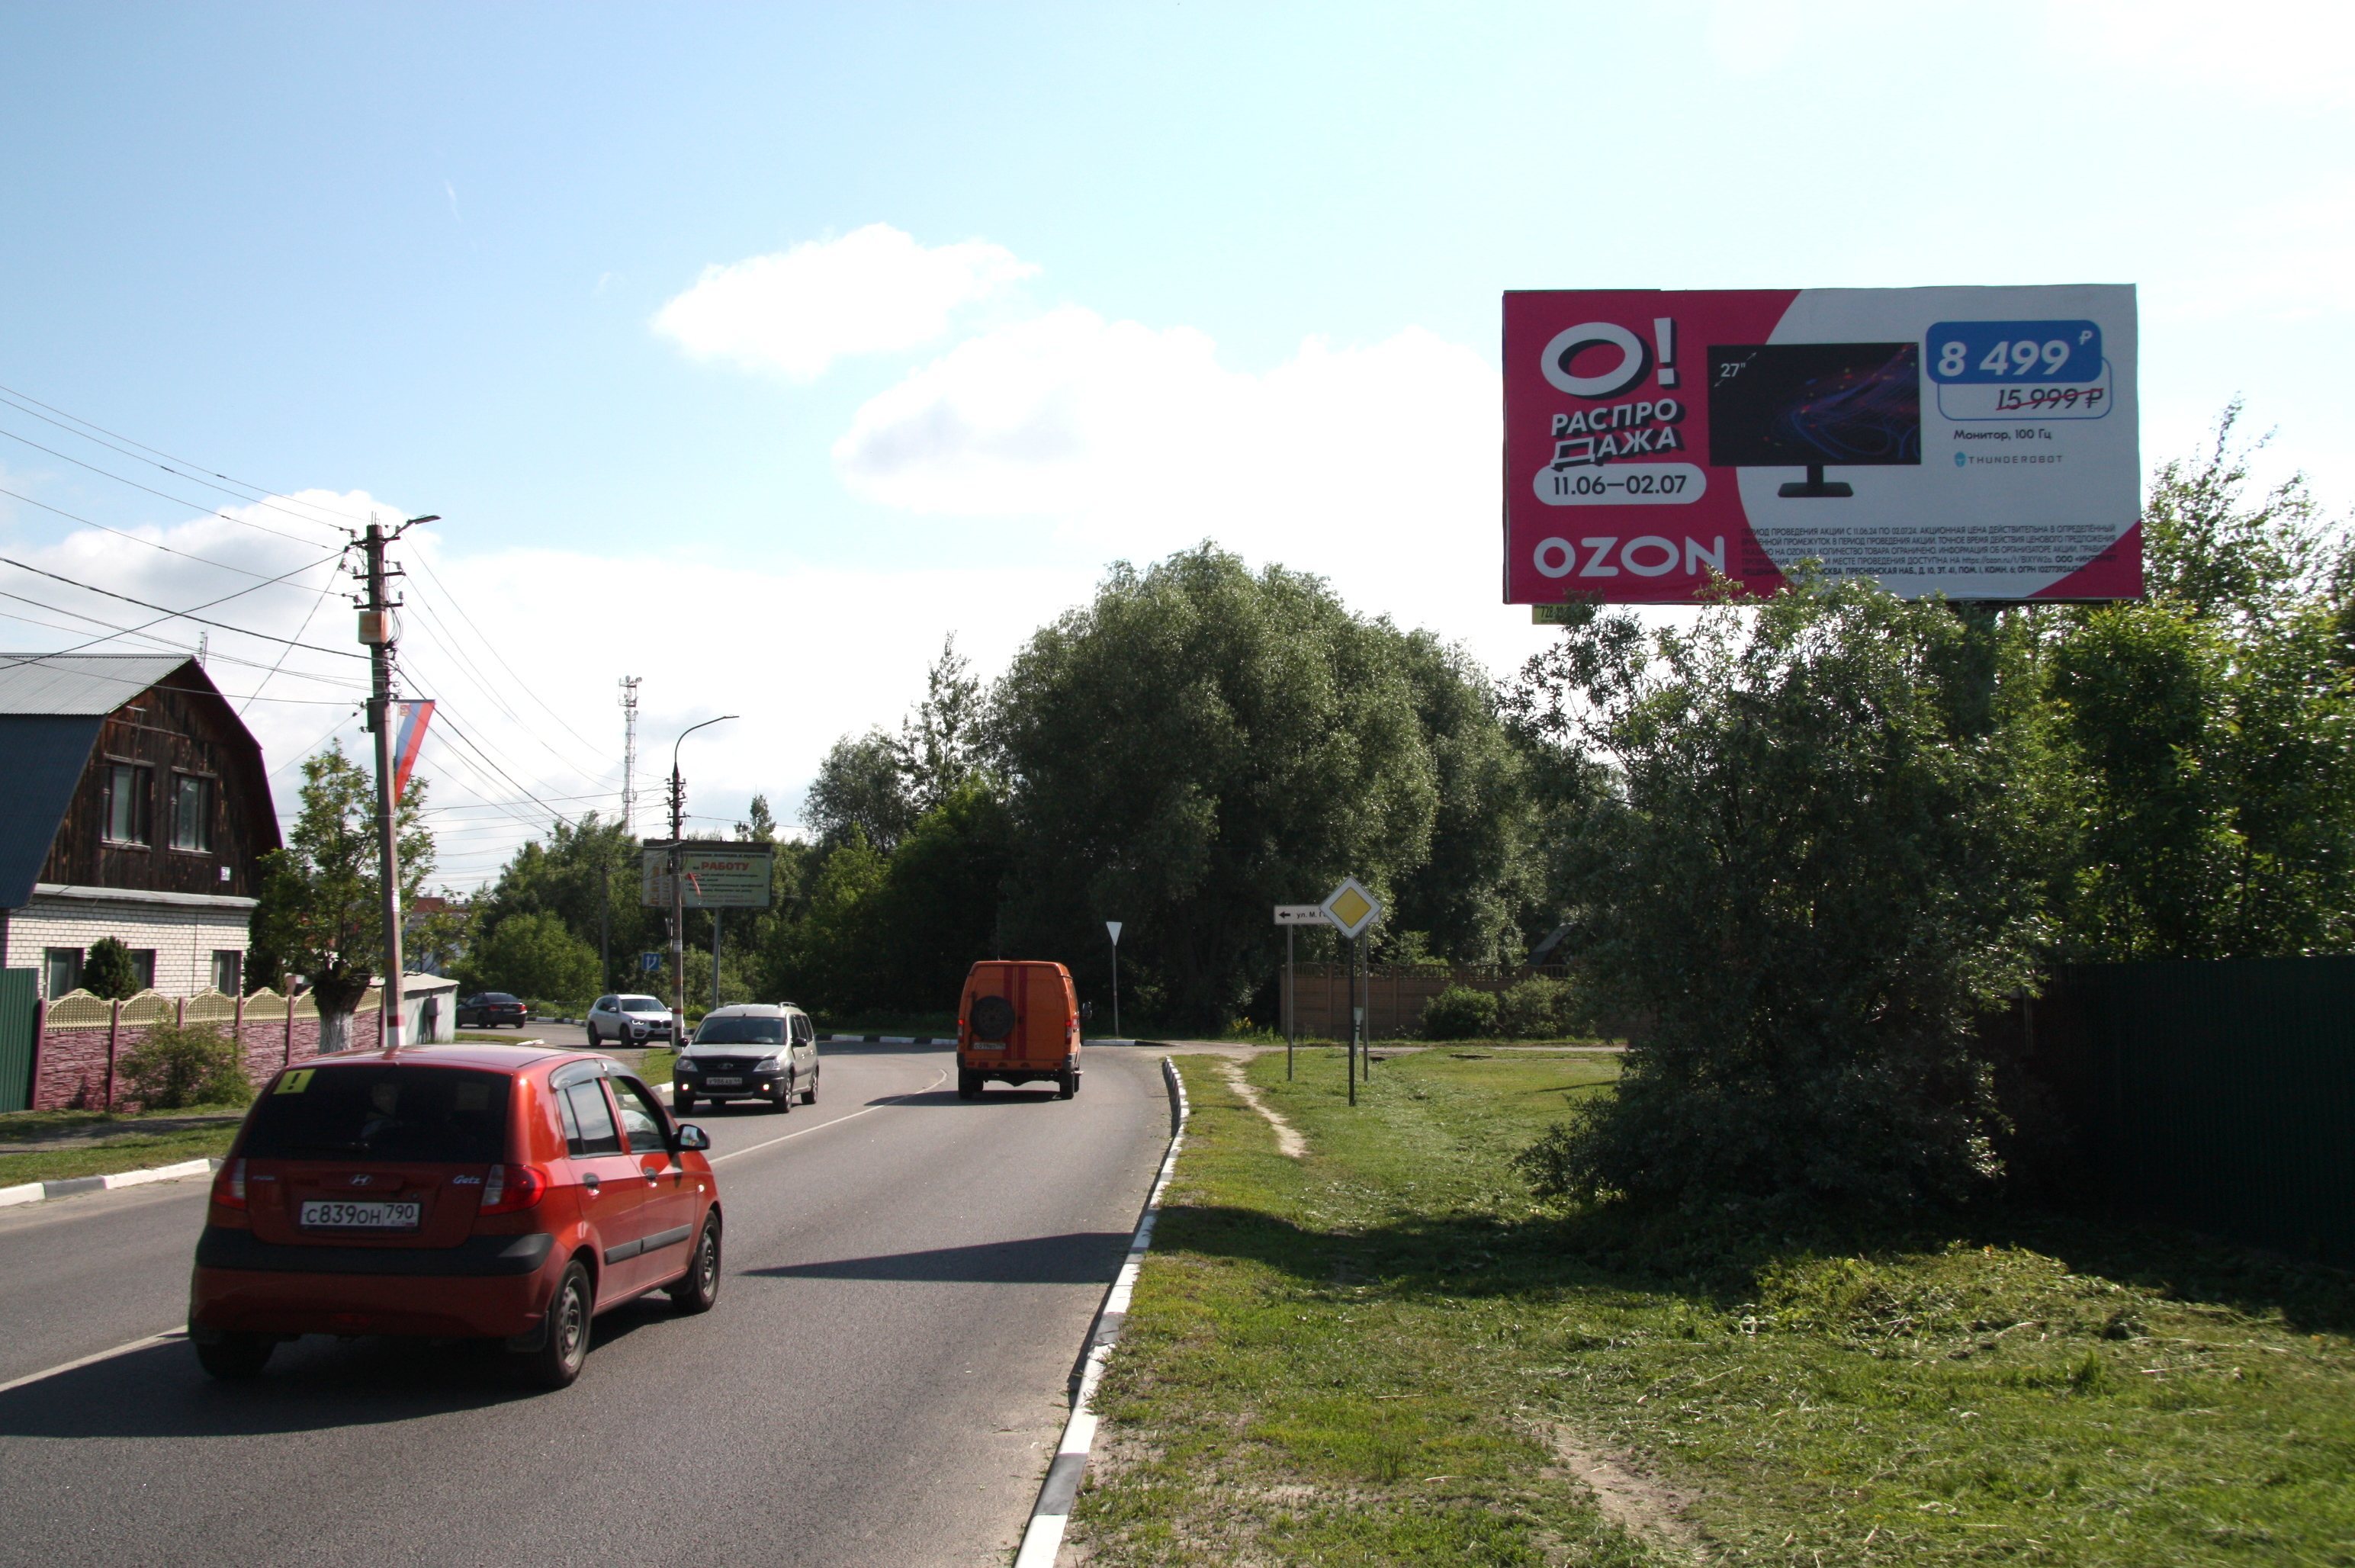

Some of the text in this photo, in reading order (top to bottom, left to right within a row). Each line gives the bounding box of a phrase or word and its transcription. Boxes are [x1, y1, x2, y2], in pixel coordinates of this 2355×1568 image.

[1541, 317, 1675, 397] О!
[1938, 341, 1967, 377] 8
[1979, 339, 2071, 376] 499
[1720, 362, 1746, 378] 27"
[1998, 389, 2022, 410] 15
[2029, 388, 2079, 410] 999
[1551, 398, 1678, 437] РАСПРО
[1954, 429, 2052, 442] Монитор, 100 Гц
[1550, 426, 1678, 468] ДАЖА
[1969, 455, 2063, 464] THUNDEROBOT
[1742, 537, 1782, 545] ВРЕННОЙ
[1839, 537, 1865, 545] ПЕРИОД
[1990, 535, 2024, 544] ДЕЙСТВИЯ
[1772, 528, 1818, 536] ПРОВЕДЕНИЯ
[1820, 527, 1845, 535] АКЦИИ
[1920, 526, 1965, 535] АКЦИОННАЯ
[1968, 525, 1987, 534] ЦЕНА
[1989, 525, 2048, 534] ДЕЙСТВИТЕЛЬНА
[1534, 535, 1725, 578] OZON
[701, 862, 750, 871] РАБОТУ
[307, 1204, 414, 1224] С839ОН 790
